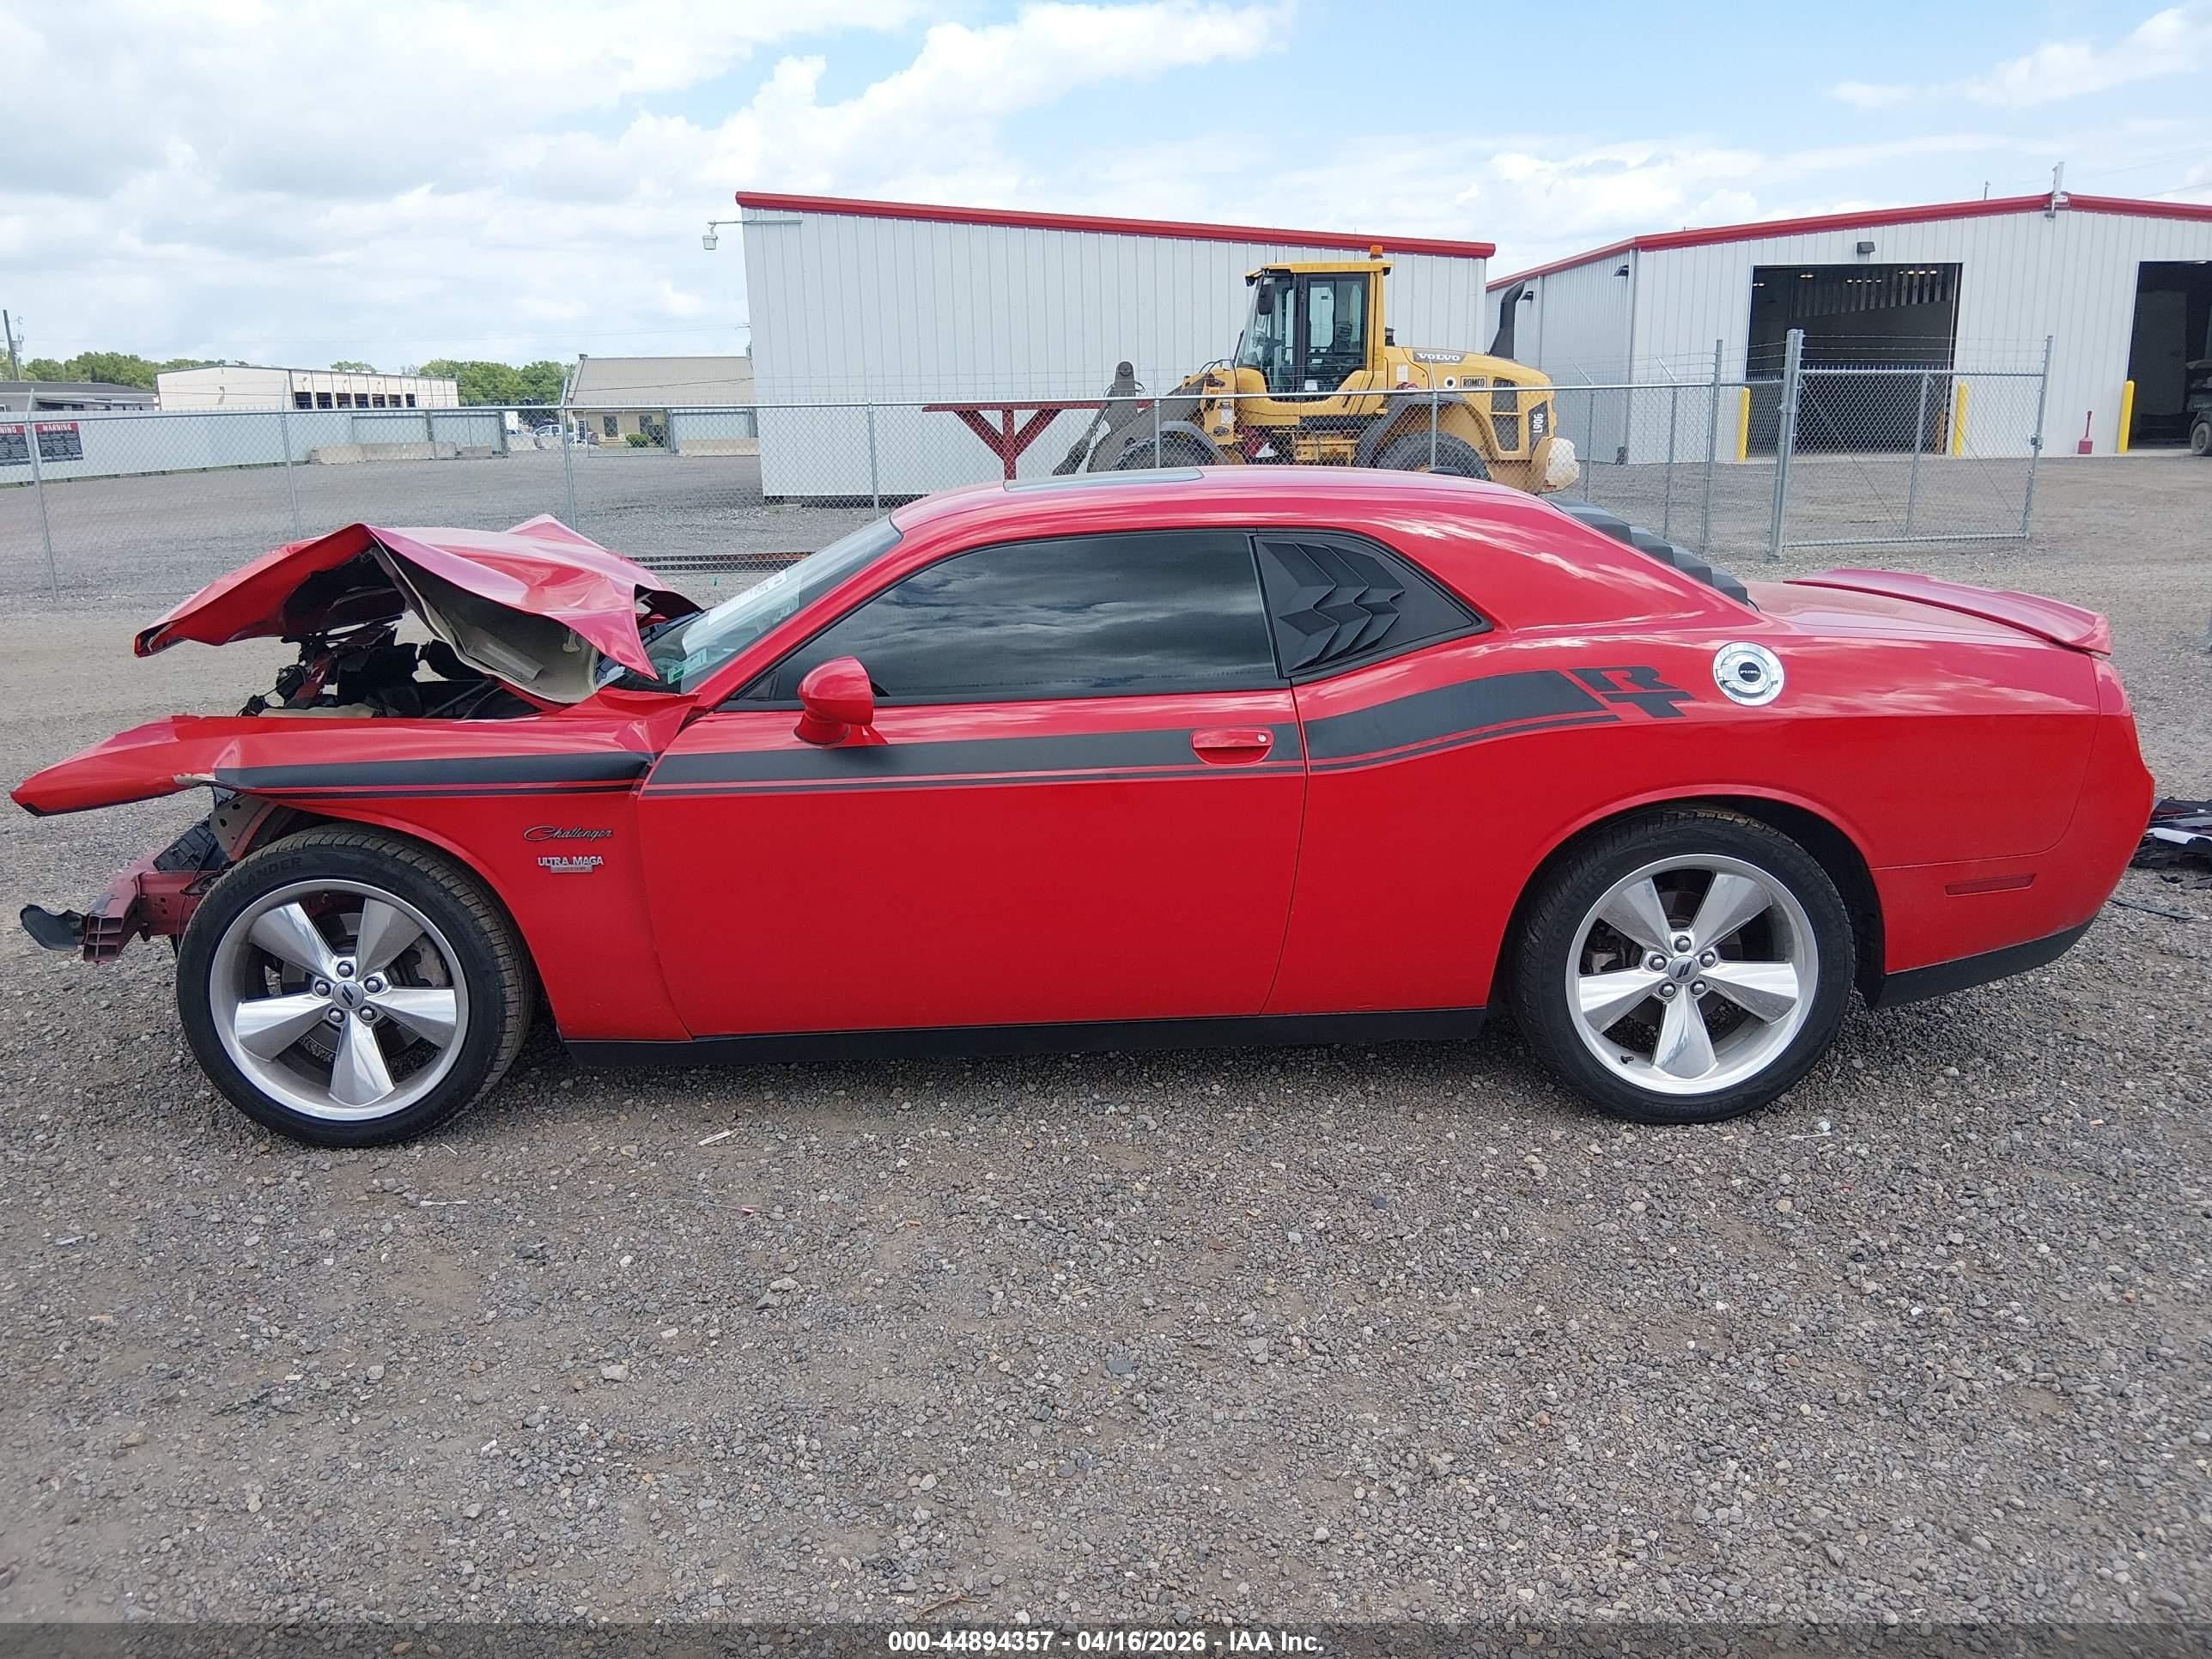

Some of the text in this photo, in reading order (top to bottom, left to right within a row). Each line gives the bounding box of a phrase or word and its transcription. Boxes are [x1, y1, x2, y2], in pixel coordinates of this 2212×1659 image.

[1417, 352, 1461, 362] VOLVO
[1462, 378, 1485, 387] ROMCO
[42, 423, 72, 432] WARNING
[523, 825, 613, 842] Challenger
[537, 855, 605, 866] ULTRA MAGA
